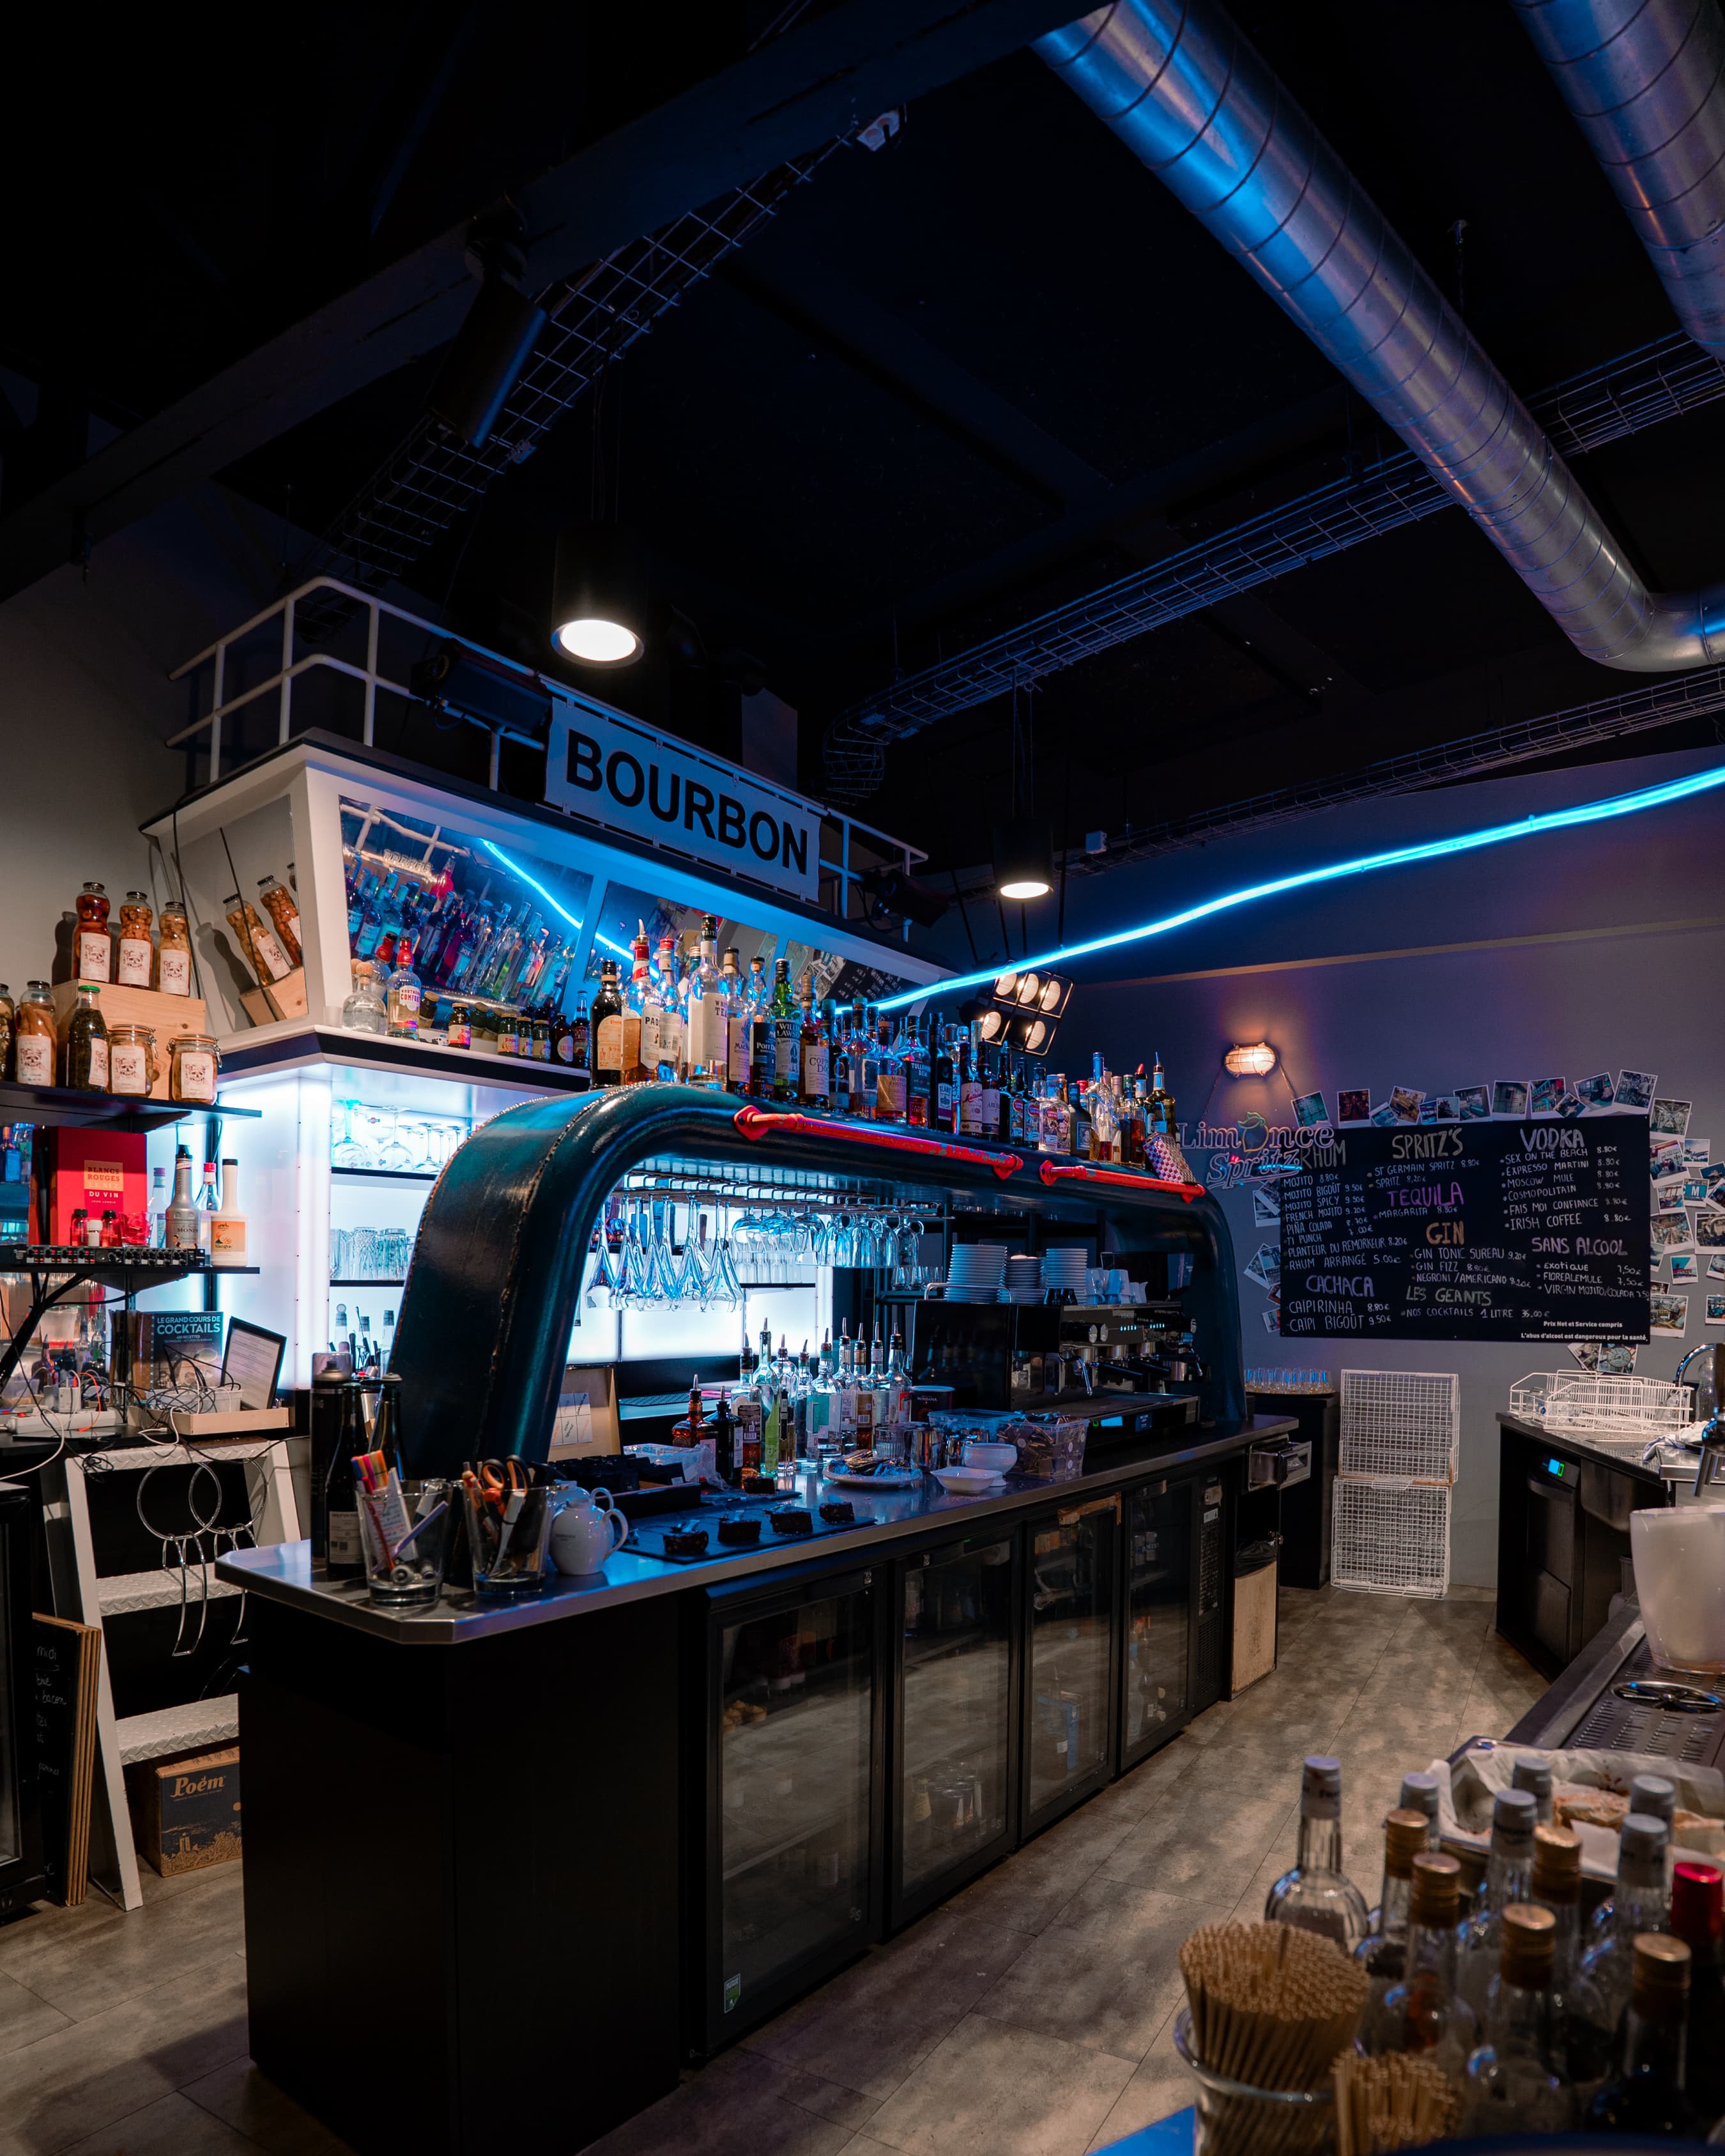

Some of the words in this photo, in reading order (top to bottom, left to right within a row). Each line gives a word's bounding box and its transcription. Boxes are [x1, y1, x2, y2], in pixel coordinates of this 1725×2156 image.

[567, 729, 808, 875] BOURBON
[1392, 1128, 1464, 1159] SPRITZ'S
[1520, 1128, 1585, 1152] VODKA
[1300, 1140, 1347, 1170] RHUM
[1505, 1154, 1521, 1165] SEX
[1524, 1152, 1537, 1161] ON
[1541, 1151, 1556, 1159] THE
[1560, 1149, 1588, 1158] BEACH
[1597, 1146, 1618, 1154] 8.80€
[1206, 1148, 1301, 1189] Spritz
[1374, 1166, 1384, 1177] ST
[1387, 1163, 1425, 1175] GERMAIN
[1429, 1161, 1455, 1172] SPRITZ
[1506, 1163, 1548, 1177] EXPRESSO
[1554, 1160, 1589, 1171] MARTINI
[1597, 1158, 1620, 1166] 8.80€
[1284, 1175, 1313, 1188] MOJITO
[1376, 1176, 1400, 1189] SPRITZ
[1507, 1176, 1544, 1188] MOSCOW
[1553, 1173, 1574, 1183] MULE
[1284, 1188, 1312, 1201] MOJITO
[1316, 1182, 1341, 1197] BIGOÛT
[1386, 1182, 1464, 1207] TEQUILA
[1508, 1185, 1577, 1202] COSMOPOLITAIN
[1691, 1186, 1699, 1197] M
[1285, 1200, 1312, 1212] MOJITO
[1317, 1196, 1339, 1208] SPICY
[1510, 1203, 1528, 1216] FAIS
[1532, 1202, 1547, 1212] MOI
[1553, 1198, 1598, 1211] CONFIANCE
[1285, 1210, 1314, 1223] FRENCH
[1318, 1206, 1342, 1218] MOJITO
[1379, 1207, 1428, 1219] MARGARITA
[1286, 1221, 1305, 1235] PIÑA
[1309, 1221, 1333, 1232] COLADA
[1510, 1217, 1540, 1230] IRISH
[1547, 1213, 1583, 1227] COFFEE
[1287, 1237, 1294, 1246] TI
[1299, 1233, 1322, 1244] PUNCH
[1426, 1221, 1464, 1245] GIN
[1288, 1245, 1326, 1258] PLANTEUR
[1330, 1243, 1340, 1253] DU
[1414, 1248, 1433, 1259] GIN
[1438, 1247, 1466, 1259] TONIC
[1469, 1248, 1505, 1259] SUREAU
[1531, 1237, 1570, 1254] SANS
[1575, 1237, 1628, 1256] ALCOOL
[1289, 1258, 1315, 1271] RHUM
[1324, 1253, 1367, 1268] ARRANGÉ
[1416, 1262, 1433, 1271] GIN
[1440, 1261, 1459, 1272] FIZZ
[1416, 1273, 1450, 1283] NEGRONI
[1406, 1285, 1426, 1301] LES
[1435, 1287, 1492, 1306] GEANTS
[1544, 1283, 1575, 1295] VIRGIN
[1367, 1303, 1390, 1313] 8.80€
[1407, 1308, 1422, 1317] NOS
[1427, 1307, 1473, 1317] COCKTAILS
[1480, 1309, 1488, 1318] 1
[1491, 1309, 1514, 1318] LITRE
[157, 1323, 220, 1334] COCKTAILS
[1324, 1313, 1364, 1330] BIGOÛT
[36, 1646, 57, 1660] midi
[42, 1690, 66, 1706] bacon
